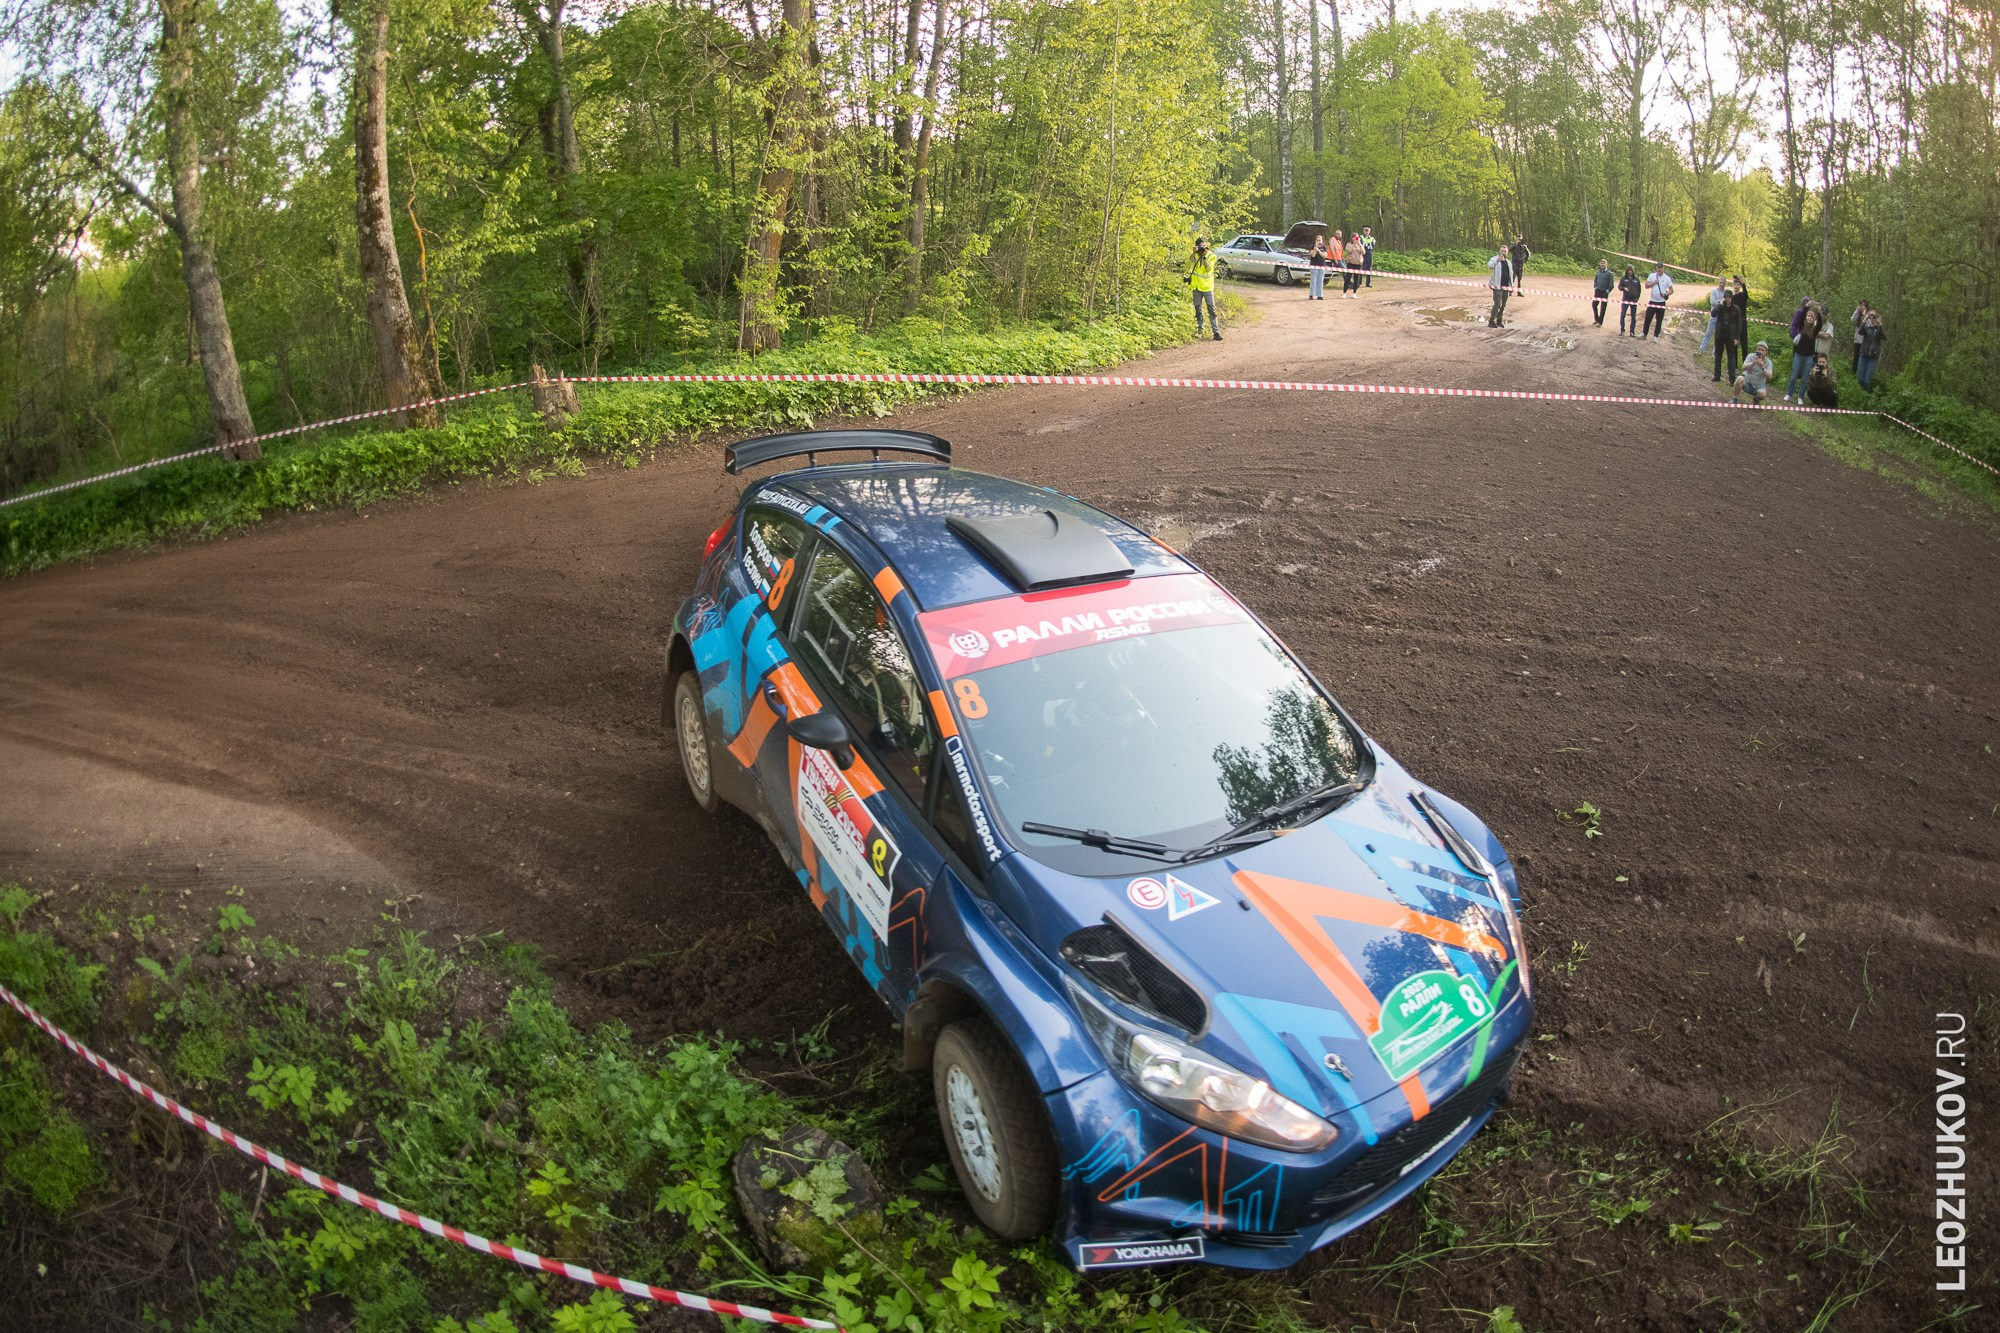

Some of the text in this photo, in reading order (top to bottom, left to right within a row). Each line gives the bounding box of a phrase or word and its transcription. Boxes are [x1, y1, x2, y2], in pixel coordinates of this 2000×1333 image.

[749, 520, 773, 568] Топоров
[743, 546, 763, 590] Теслин
[768, 558, 795, 611] 8
[992, 600, 1212, 648] РАЛЛИ РОССИИ
[953, 678, 989, 720] 8
[834, 800, 866, 854] 2025
[951, 752, 1003, 862] mrmotorsport
[872, 838, 887, 877] 8
[1137, 884, 1160, 902] E
[1399, 982, 1443, 1018] РАЛЛИ
[1459, 983, 1486, 1017] 8
[1115, 1243, 1194, 1260] YOKOHAMA
